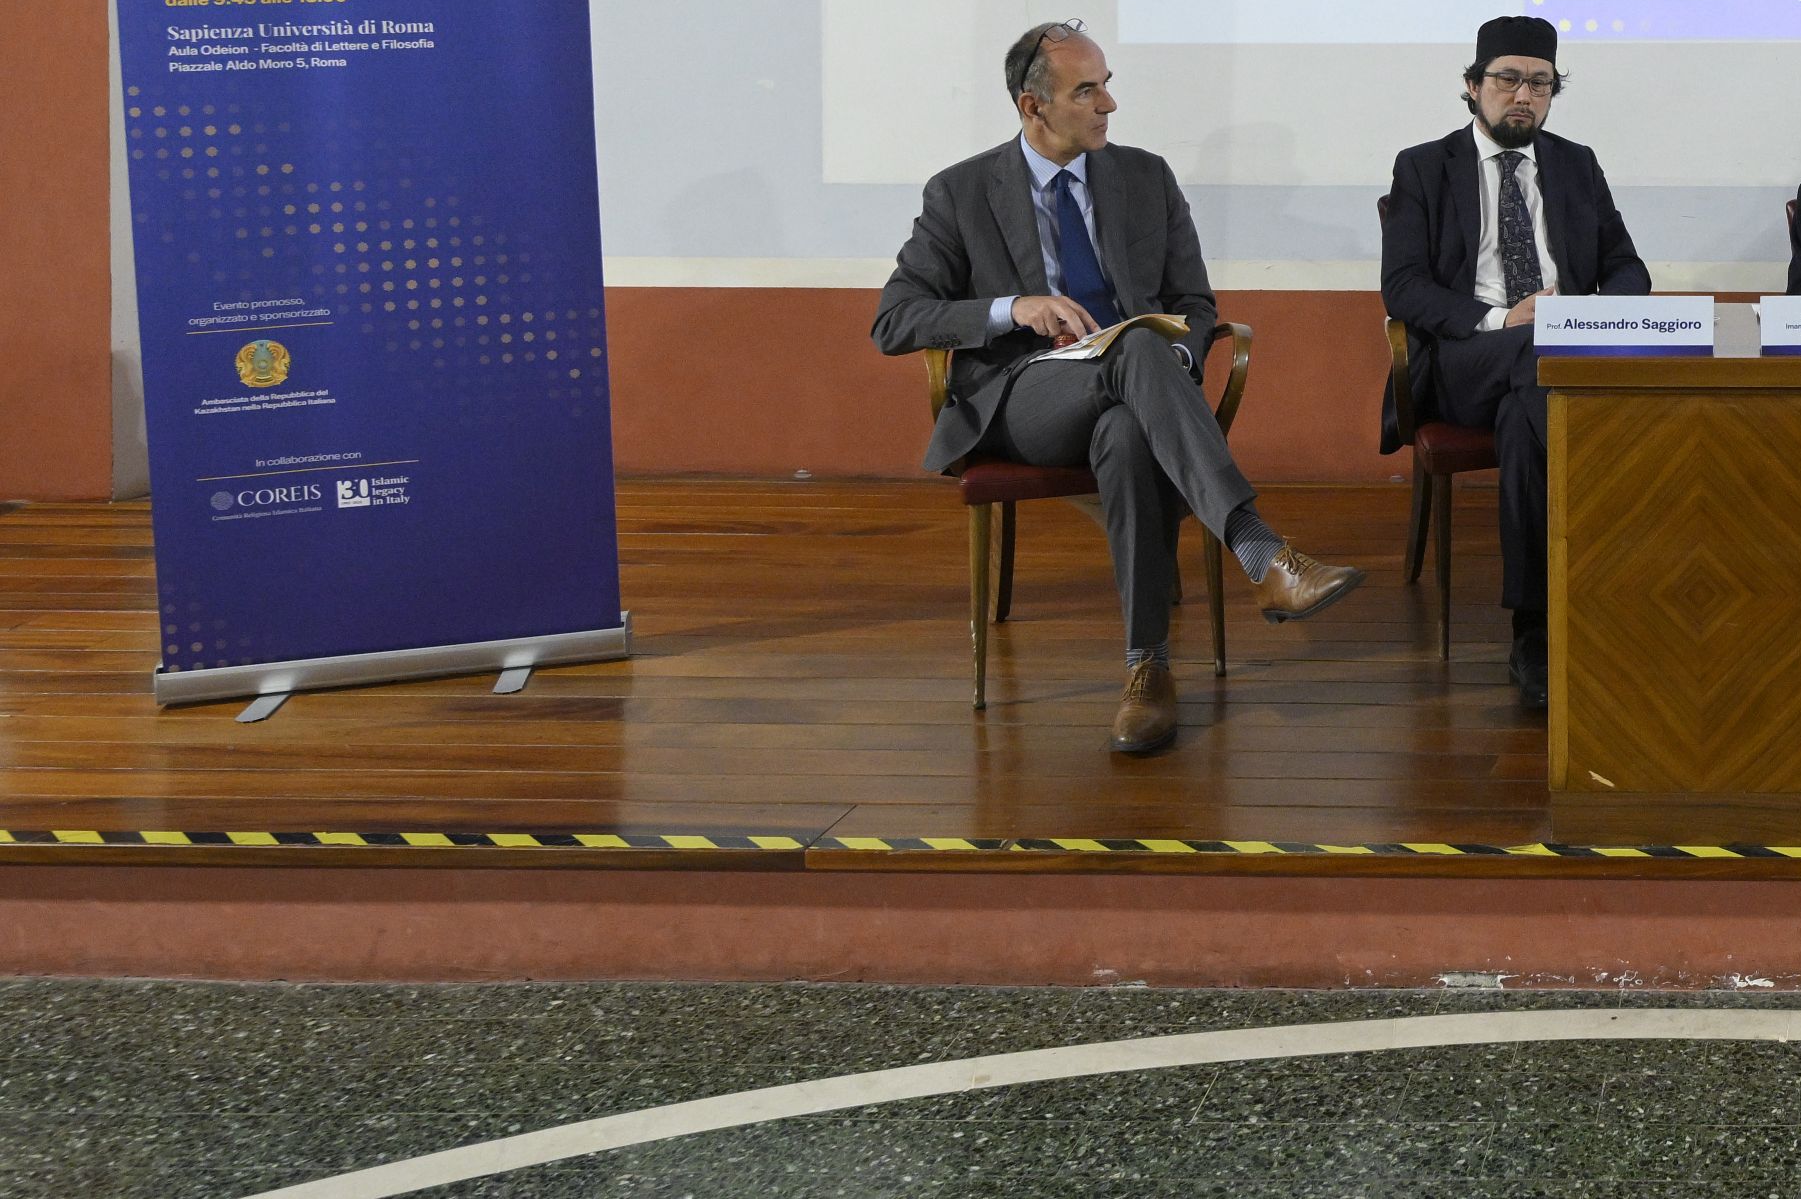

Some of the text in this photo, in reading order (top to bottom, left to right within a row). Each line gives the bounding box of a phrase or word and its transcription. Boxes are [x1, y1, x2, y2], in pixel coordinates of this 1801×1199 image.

[168, 20, 434, 42] Sapienza Università di Roma
[1564, 319, 1638, 329] Alessandro
[1642, 319, 1701, 333] Saggioro
[372, 476, 409, 486] Islamic
[238, 484, 321, 506] COREIS
[372, 488, 405, 496] legacy
[386, 495, 410, 504] Italy
